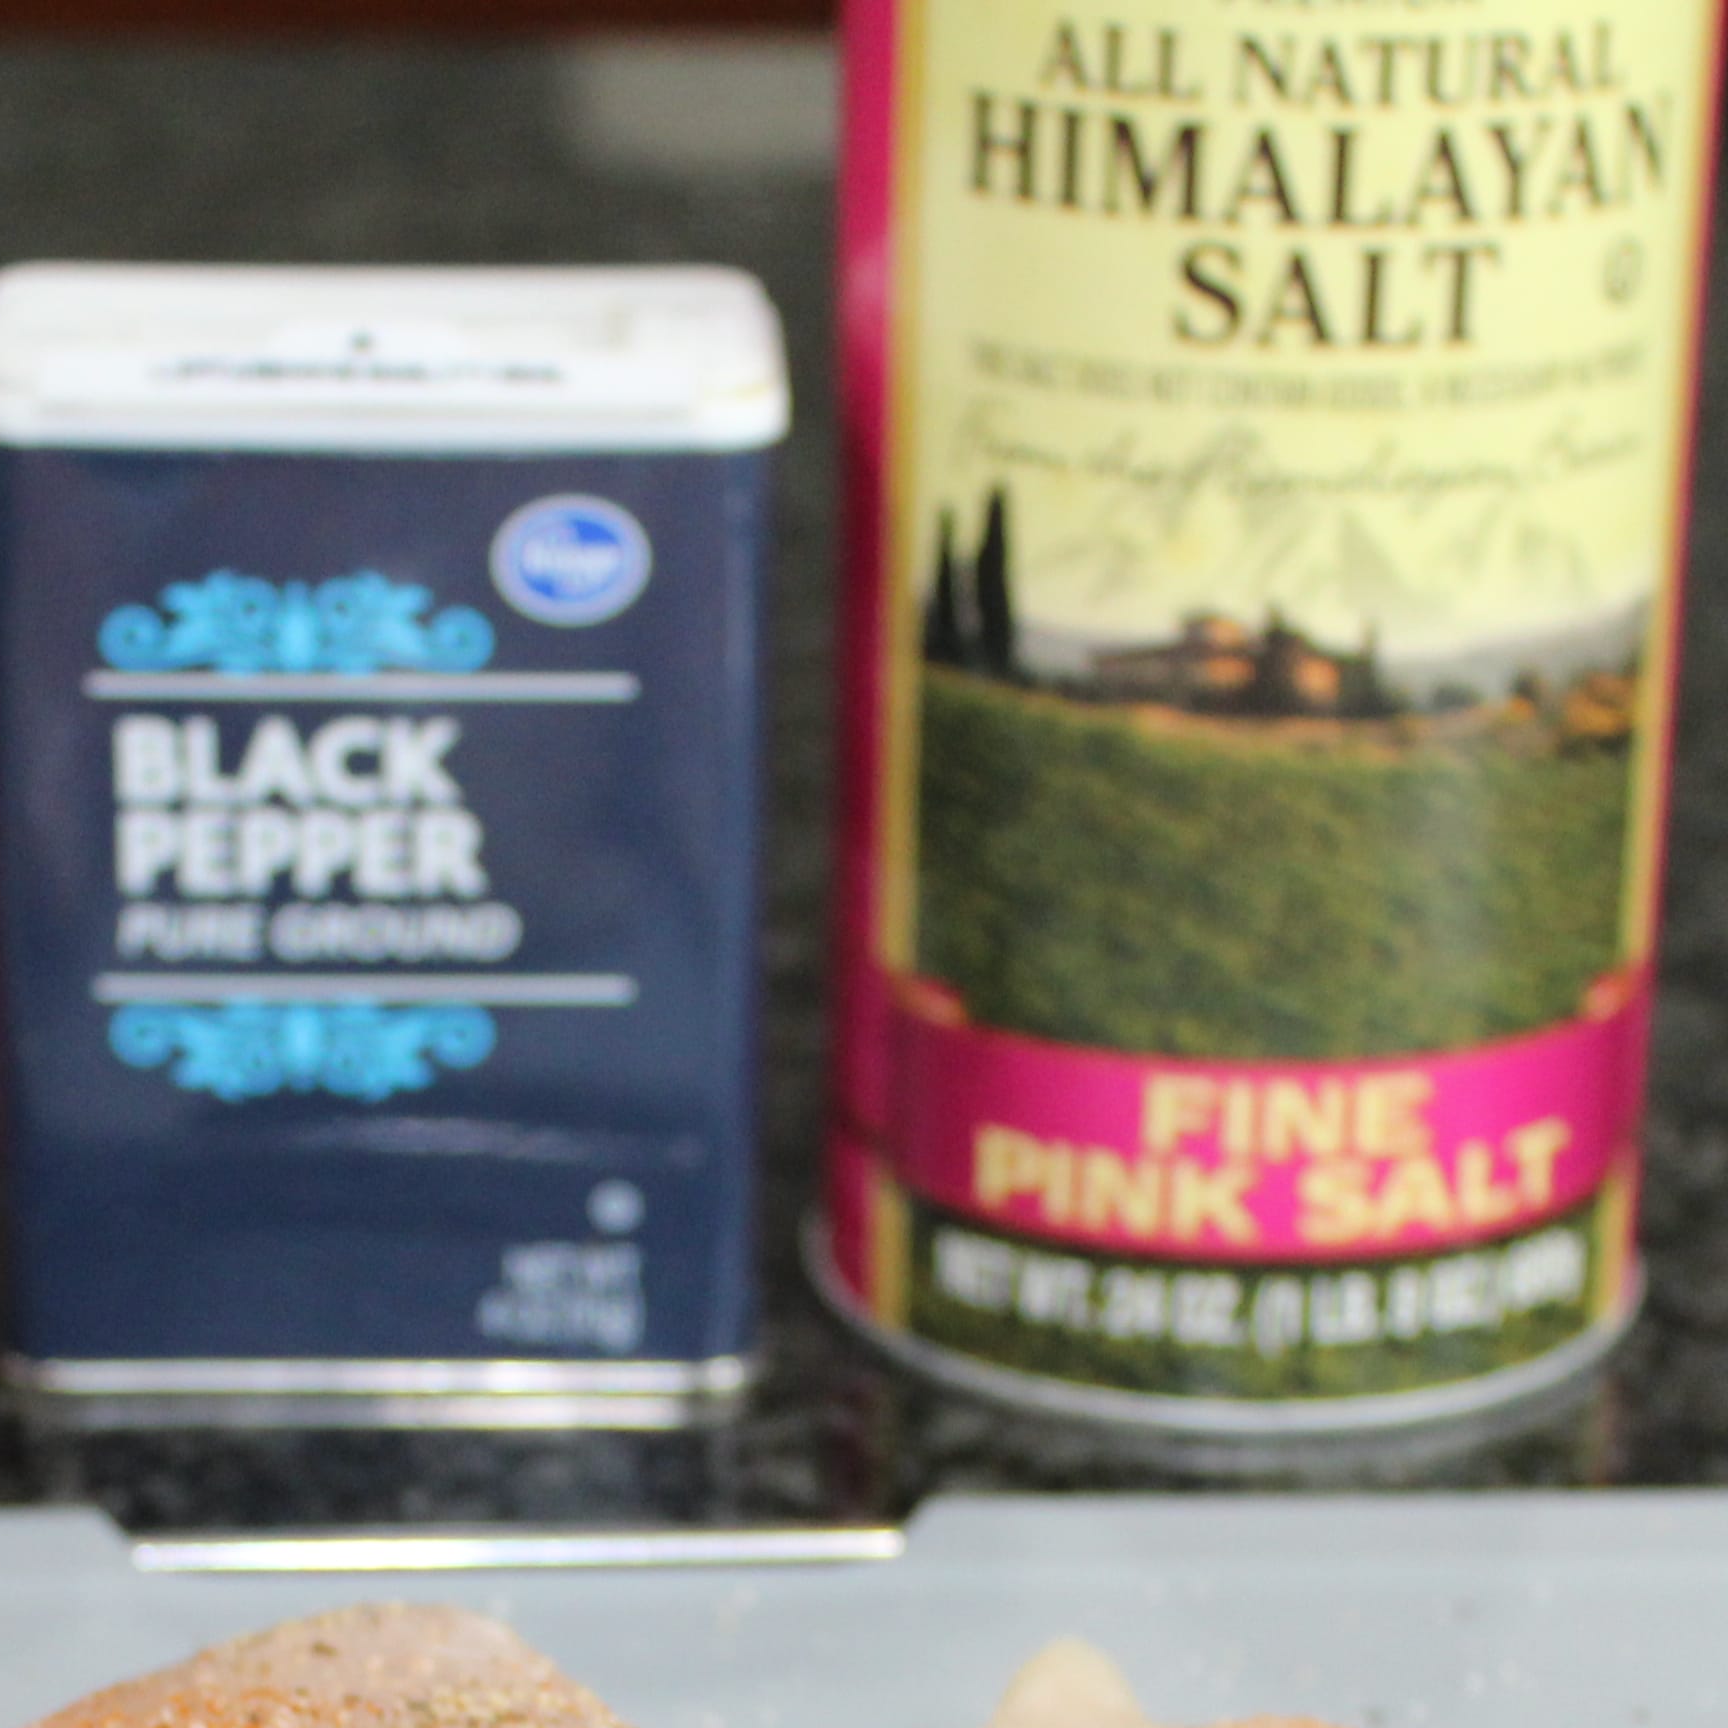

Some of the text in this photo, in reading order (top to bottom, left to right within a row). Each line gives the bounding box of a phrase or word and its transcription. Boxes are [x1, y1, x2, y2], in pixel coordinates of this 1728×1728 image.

[1040, 20, 1626, 108] ALL NATURAL
[966, 90, 1674, 232] HIMALAYAN
[1170, 240, 1504, 352] SALT
[111, 712, 463, 808] BLACK
[115, 806, 489, 900] PEPPER
[116, 900, 523, 962] PURE GROUND
[1140, 1071, 1434, 1164] FINE
[972, 1115, 1572, 1246] PINK SALT
